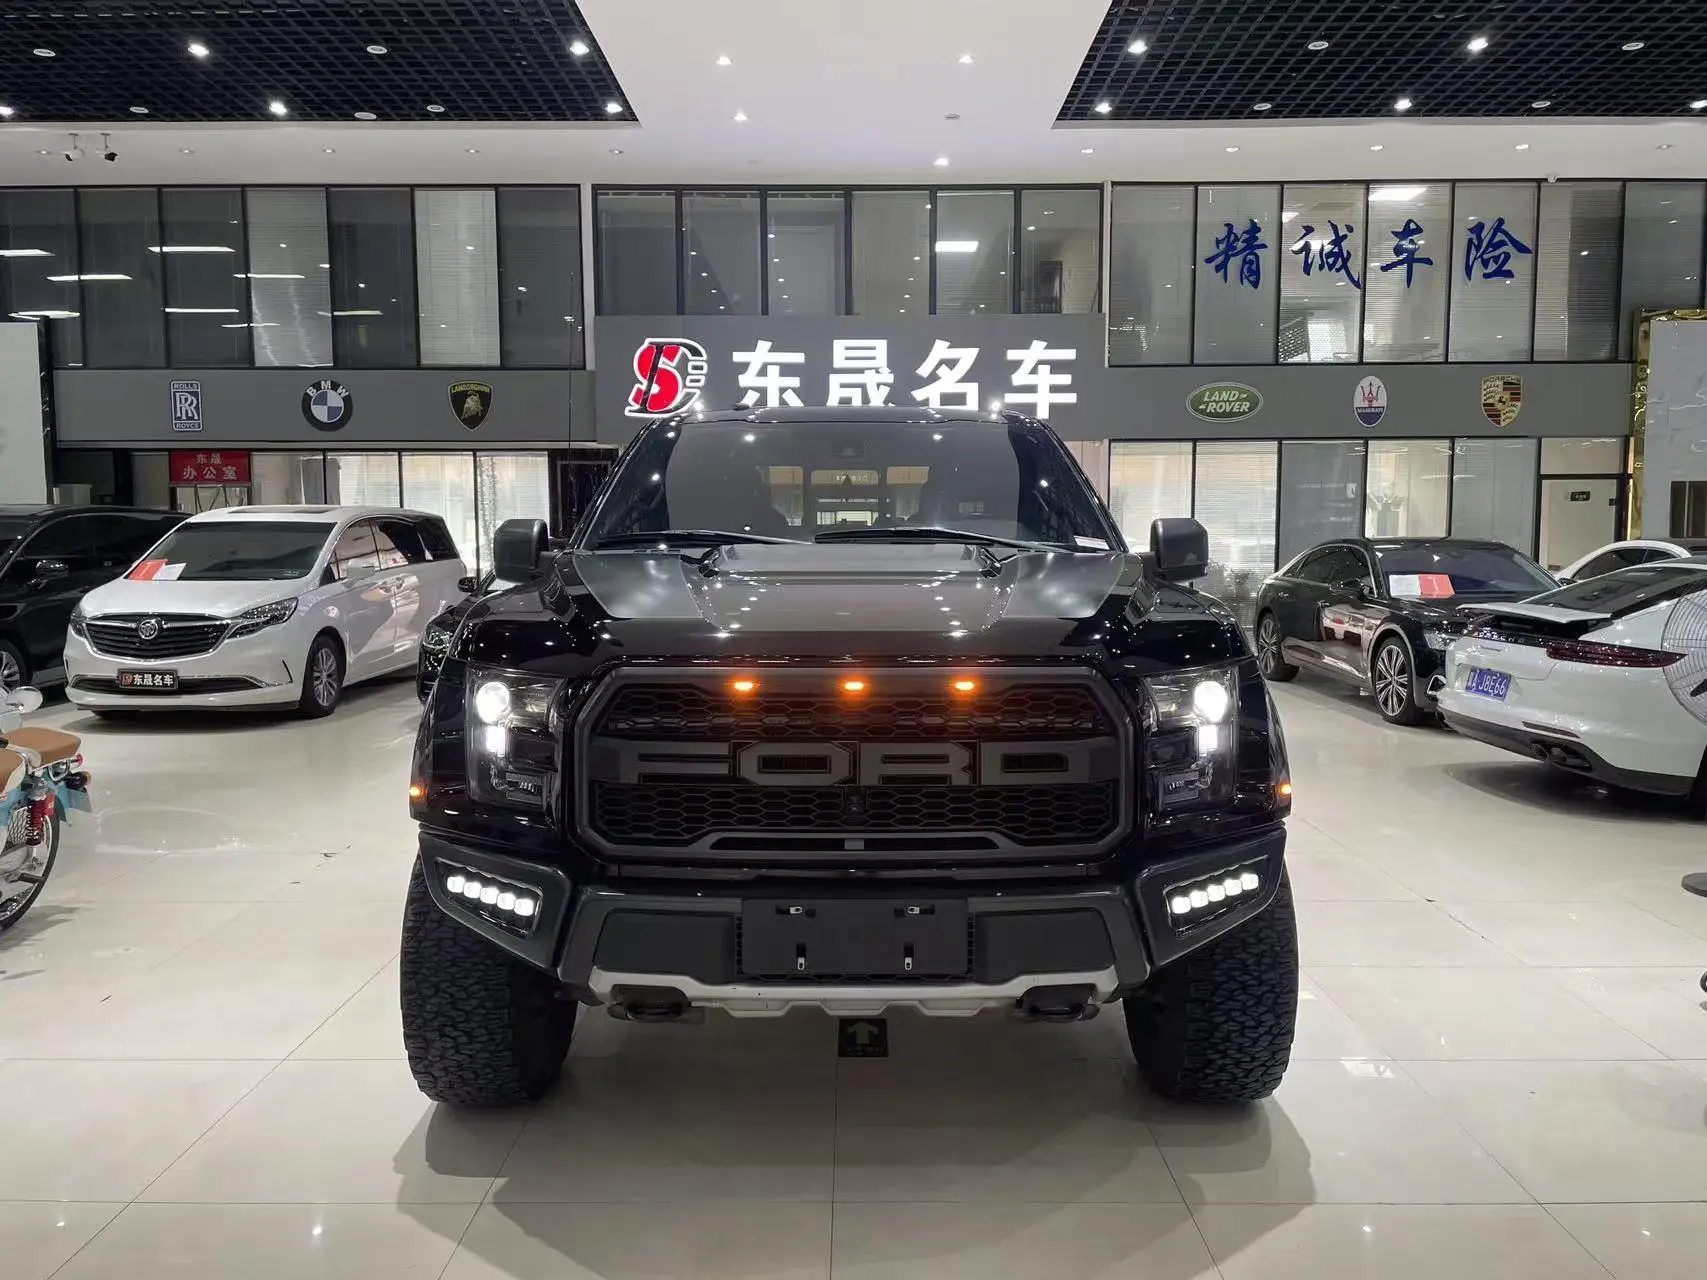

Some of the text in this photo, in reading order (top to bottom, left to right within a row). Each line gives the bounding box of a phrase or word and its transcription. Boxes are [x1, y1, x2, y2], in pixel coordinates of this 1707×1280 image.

[1205, 217, 1533, 290] 精诚车险
[732, 339, 1078, 419] 东晟名车
[306, 380, 349, 398] BMW
[1203, 390, 1239, 401] LAND
[1206, 401, 1250, 413] ROVER
[183, 466, 237, 480] 办公室
[133, 673, 174, 686] 东晟名车
[621, 740, 1088, 786] FORD
